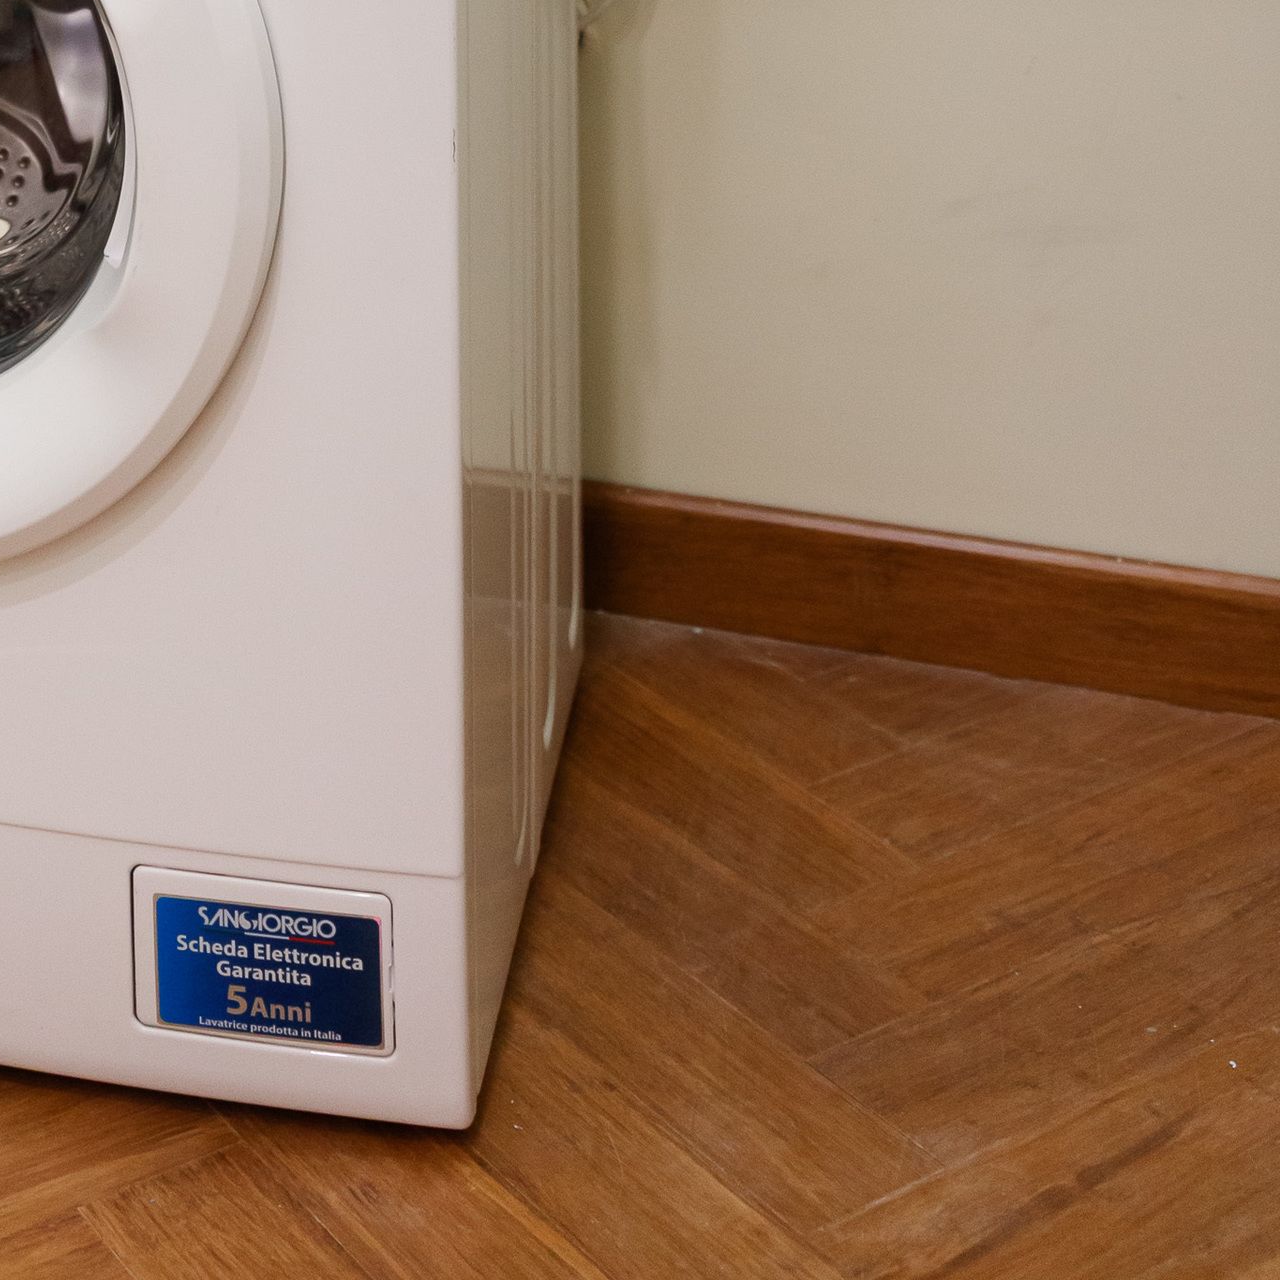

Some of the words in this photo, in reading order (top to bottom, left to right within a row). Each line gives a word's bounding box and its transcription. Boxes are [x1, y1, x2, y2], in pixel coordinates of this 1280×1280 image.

[176, 934, 249, 958] Scheda
[253, 943, 364, 971] Elettronica
[216, 960, 312, 987] Garantita
[226, 985, 249, 1016] 5
[250, 1000, 312, 1024] Anni
[198, 1016, 248, 1031] Lavatrice
[250, 1022, 299, 1038] prodotta
[301, 1028, 312, 1038] in
[313, 1028, 342, 1041] Italia
